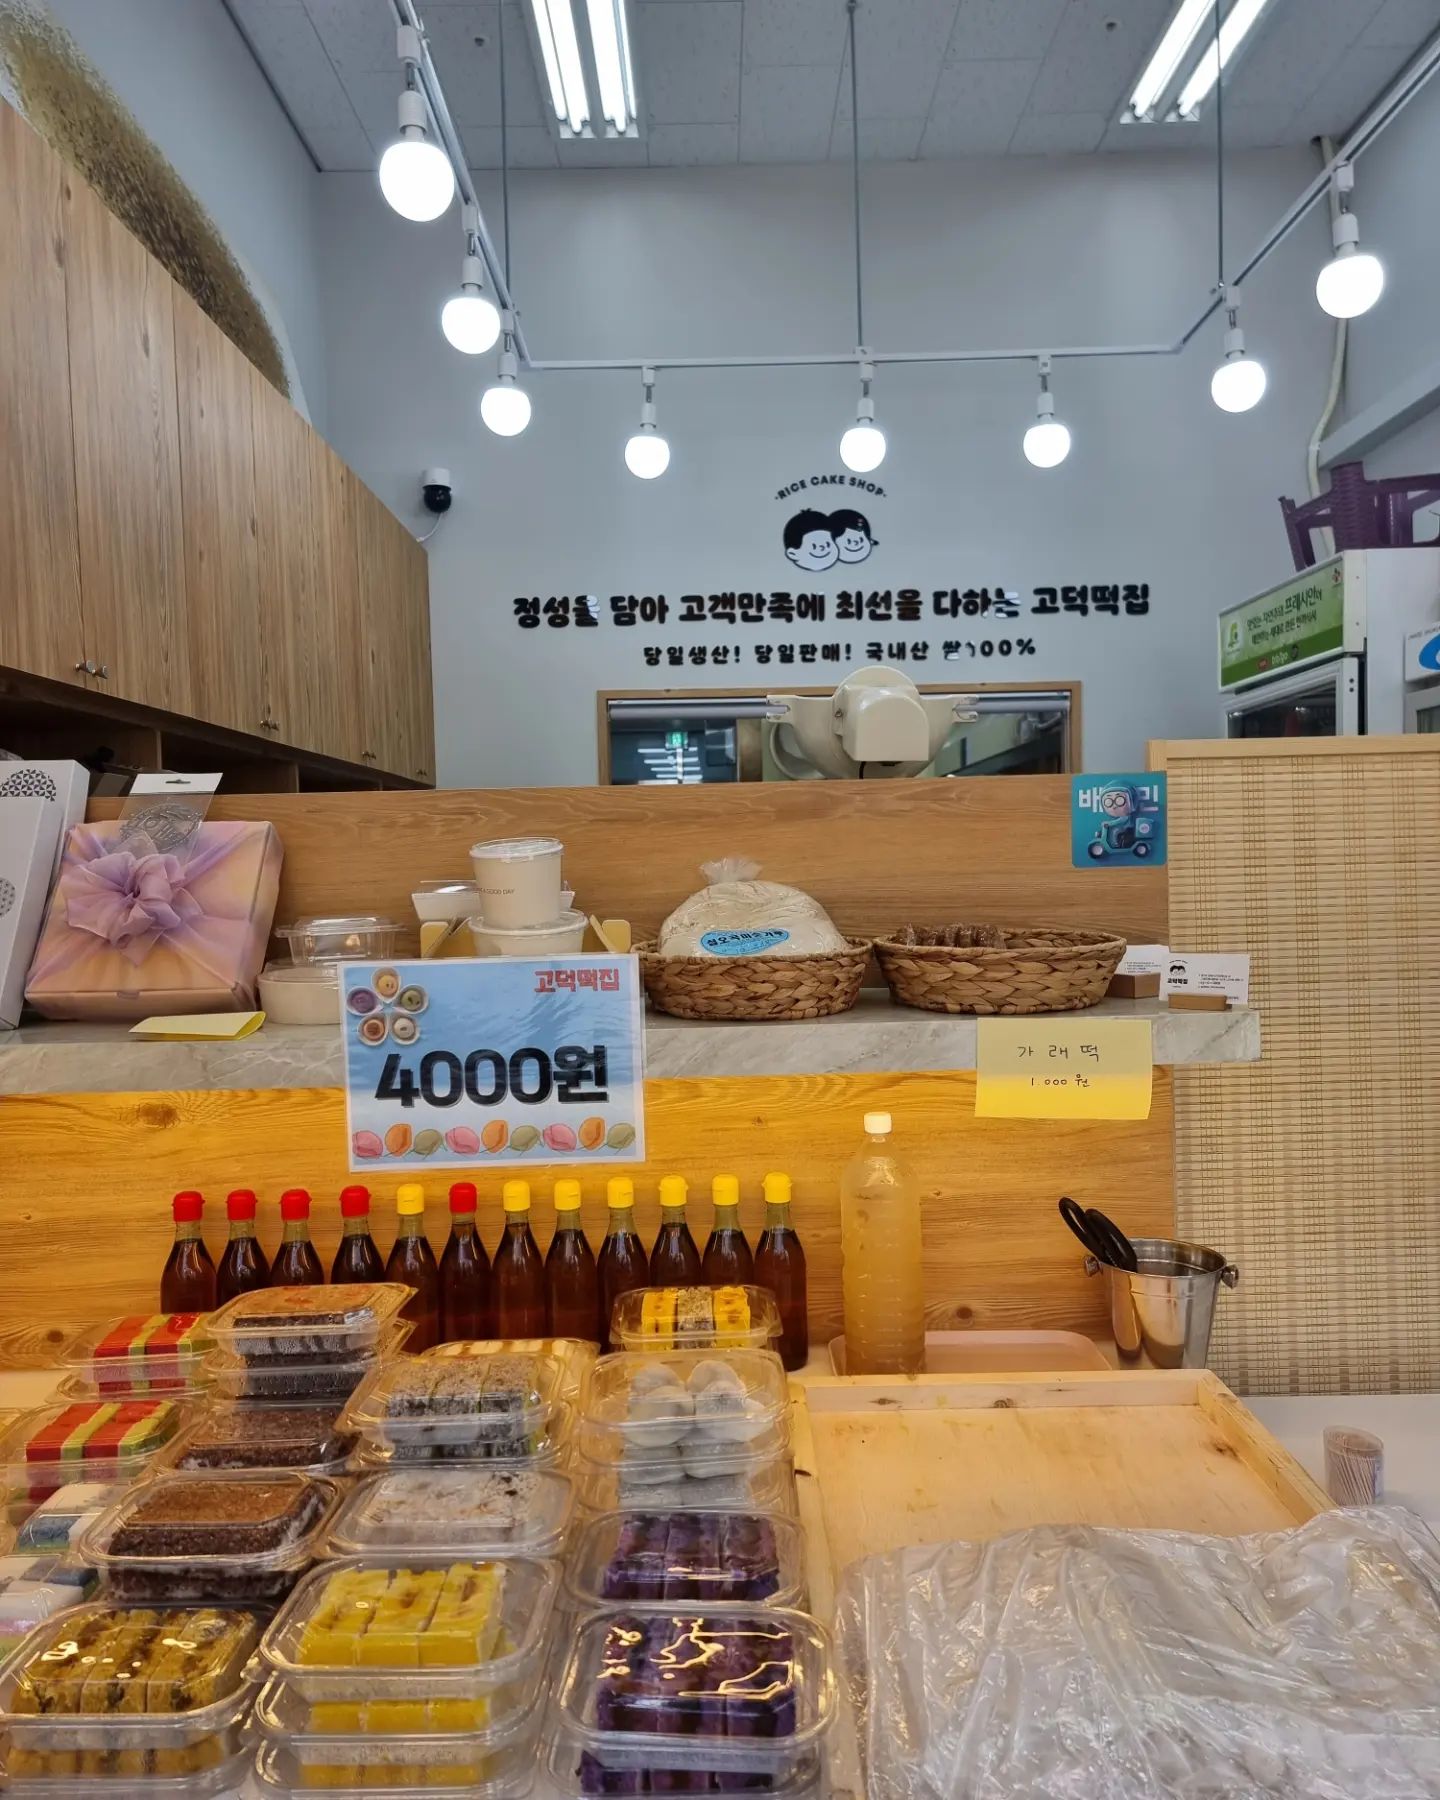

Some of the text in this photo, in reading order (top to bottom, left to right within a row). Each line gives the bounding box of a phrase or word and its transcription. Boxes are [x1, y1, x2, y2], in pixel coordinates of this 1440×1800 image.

[777, 474, 885, 500] RICE CAKE SHOP
[513, 583, 1150, 628] 정성을 담아 고객만족에 최선을 다하는 고덕떡집
[643, 645, 741, 667] 당일생산!
[755, 643, 852, 665] 당일판매!
[866, 641, 930, 662] 국내산
[533, 968, 620, 993] 고덕떡집
[375, 1044, 610, 1108] 4000원
